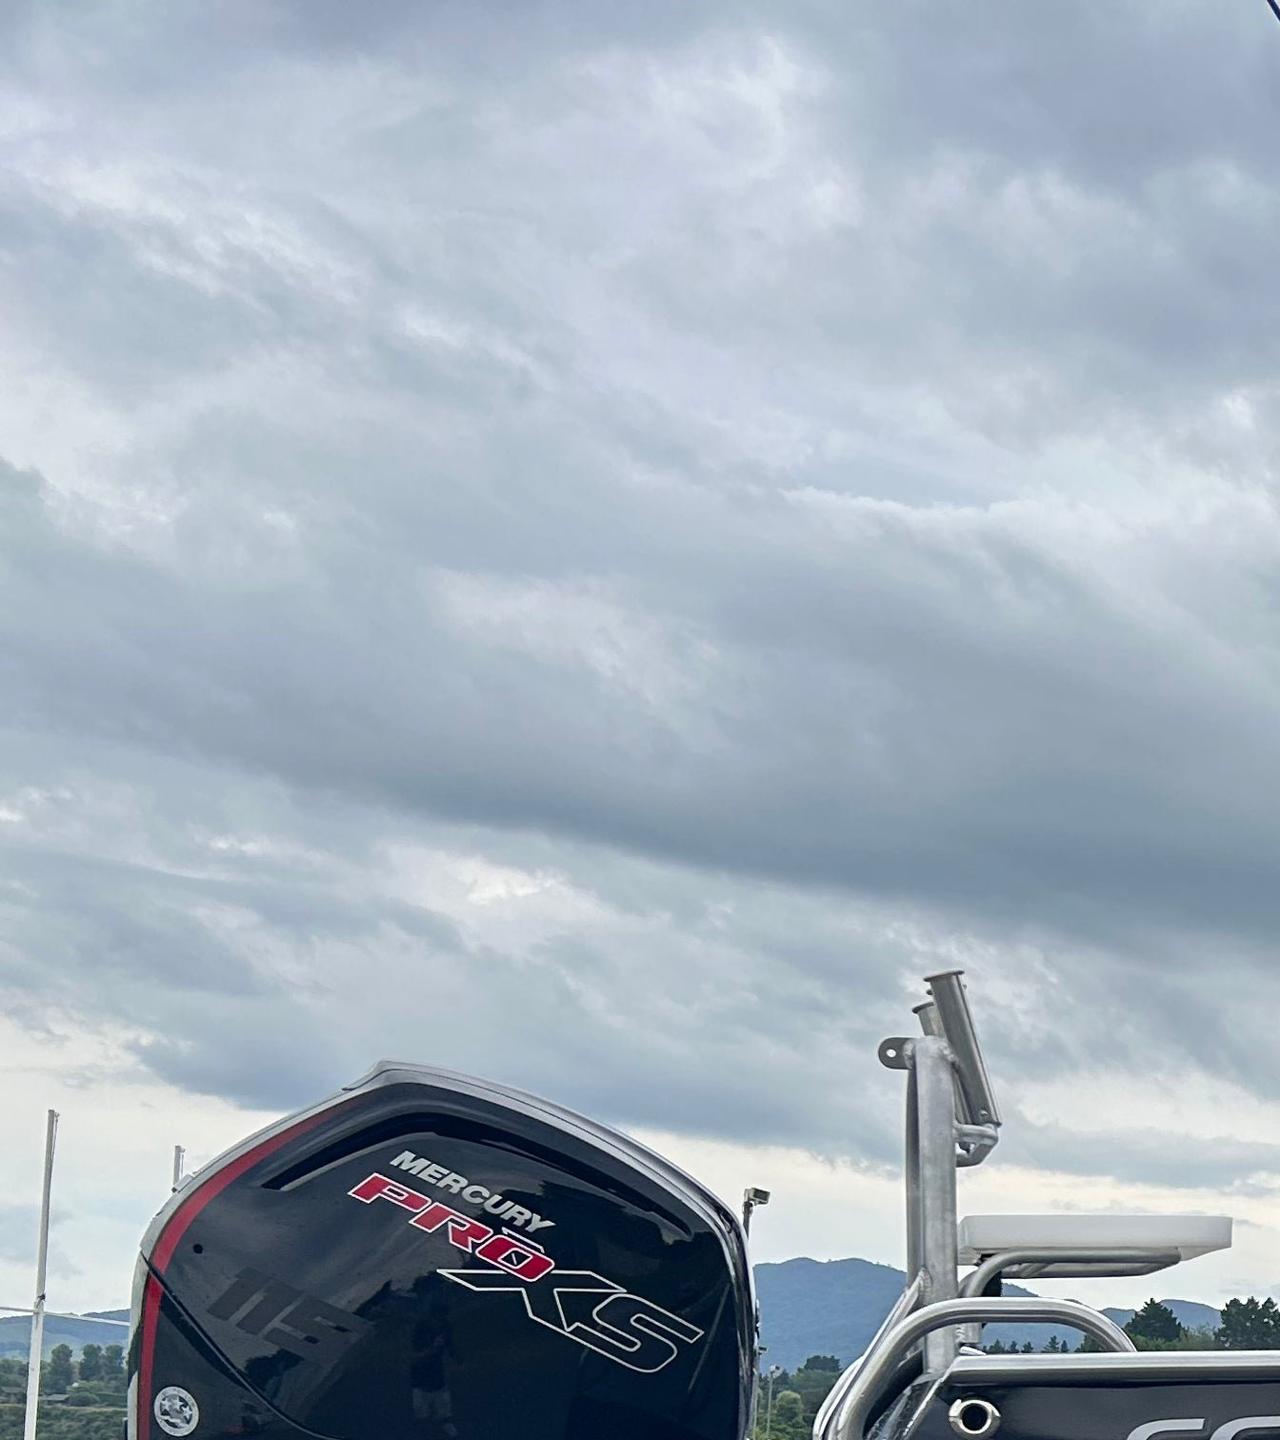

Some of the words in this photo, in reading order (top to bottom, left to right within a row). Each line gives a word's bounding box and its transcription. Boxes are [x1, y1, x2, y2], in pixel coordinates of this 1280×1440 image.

[347, 1172, 555, 1282] PRO
[389, 1150, 556, 1233] MERCURY
[207, 1266, 374, 1366] 115
[436, 1269, 705, 1373] XS
